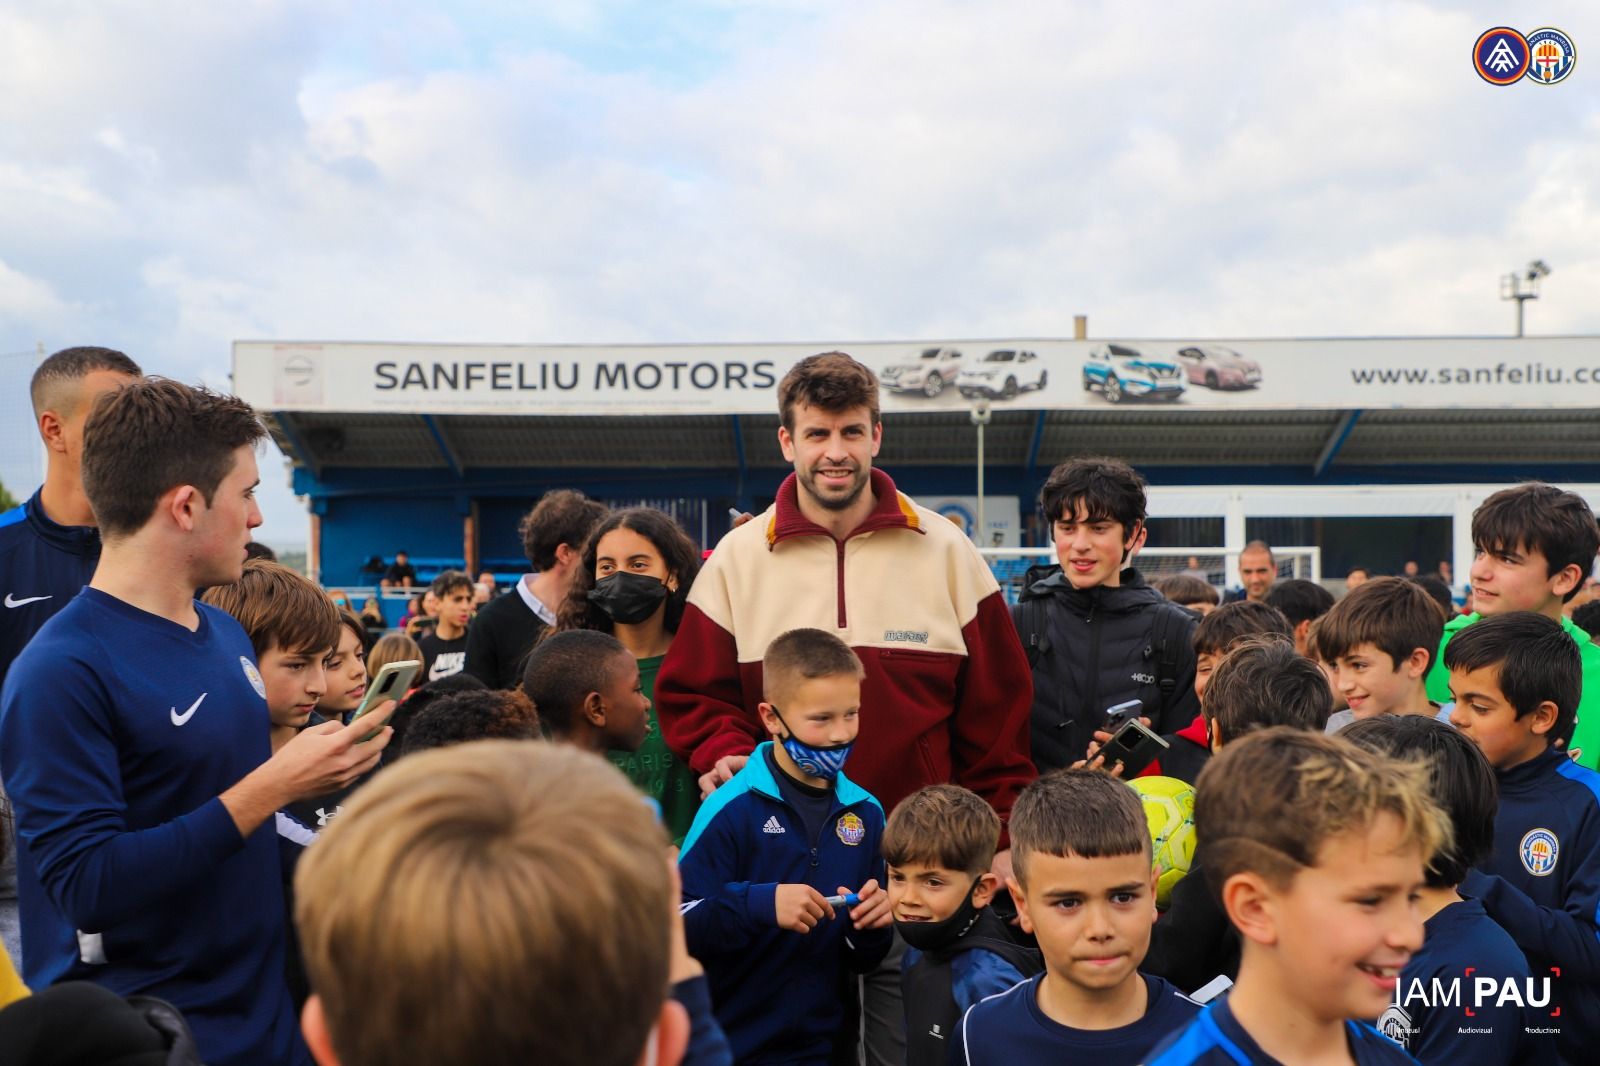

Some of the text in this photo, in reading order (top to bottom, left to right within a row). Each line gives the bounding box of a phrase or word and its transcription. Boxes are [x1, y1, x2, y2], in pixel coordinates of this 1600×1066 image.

[375, 361, 776, 391] SANFELIU MOTORS
[435, 651, 466, 673] NIKE
[614, 752, 673, 774] PARIS
[762, 826, 786, 834] adidas
